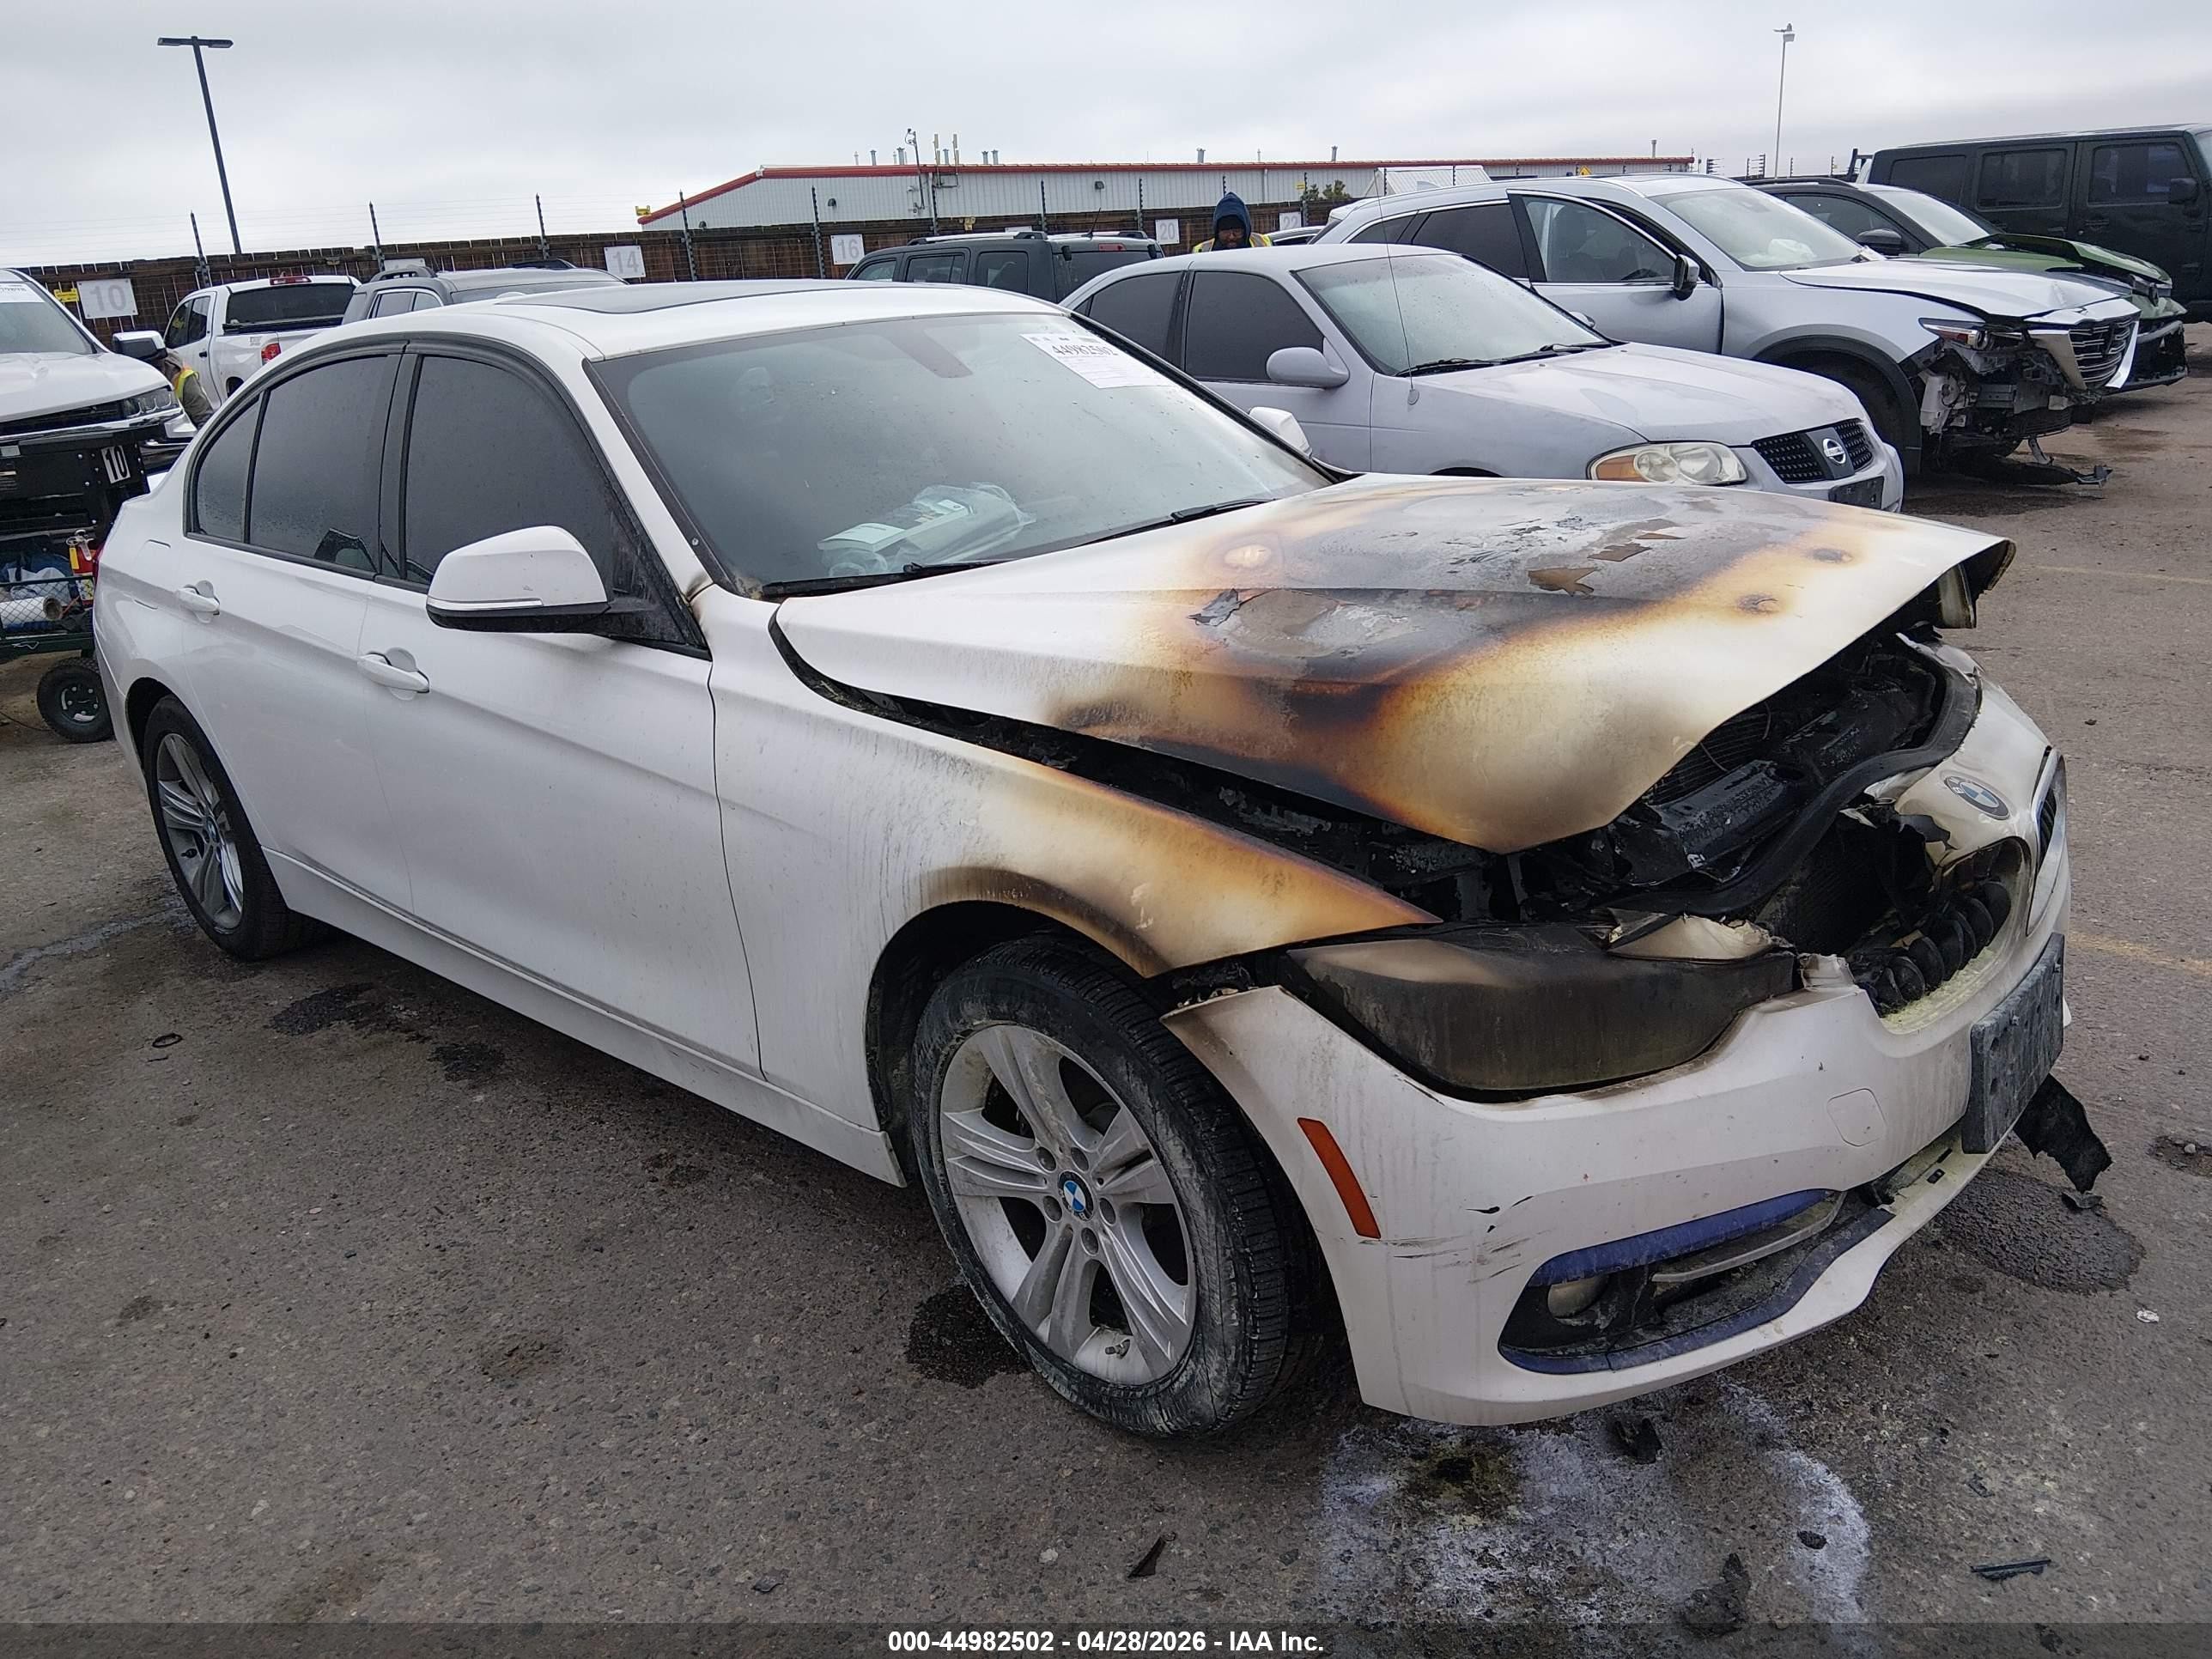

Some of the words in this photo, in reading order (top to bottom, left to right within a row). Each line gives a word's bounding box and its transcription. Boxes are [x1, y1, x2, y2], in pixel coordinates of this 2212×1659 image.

[1159, 222, 1176, 240] 20
[837, 240, 860, 259] 16
[612, 251, 640, 274] 14
[89, 284, 127, 312] 10
[1052, 344, 1119, 356] 44982502
[106, 445, 129, 481] 10
